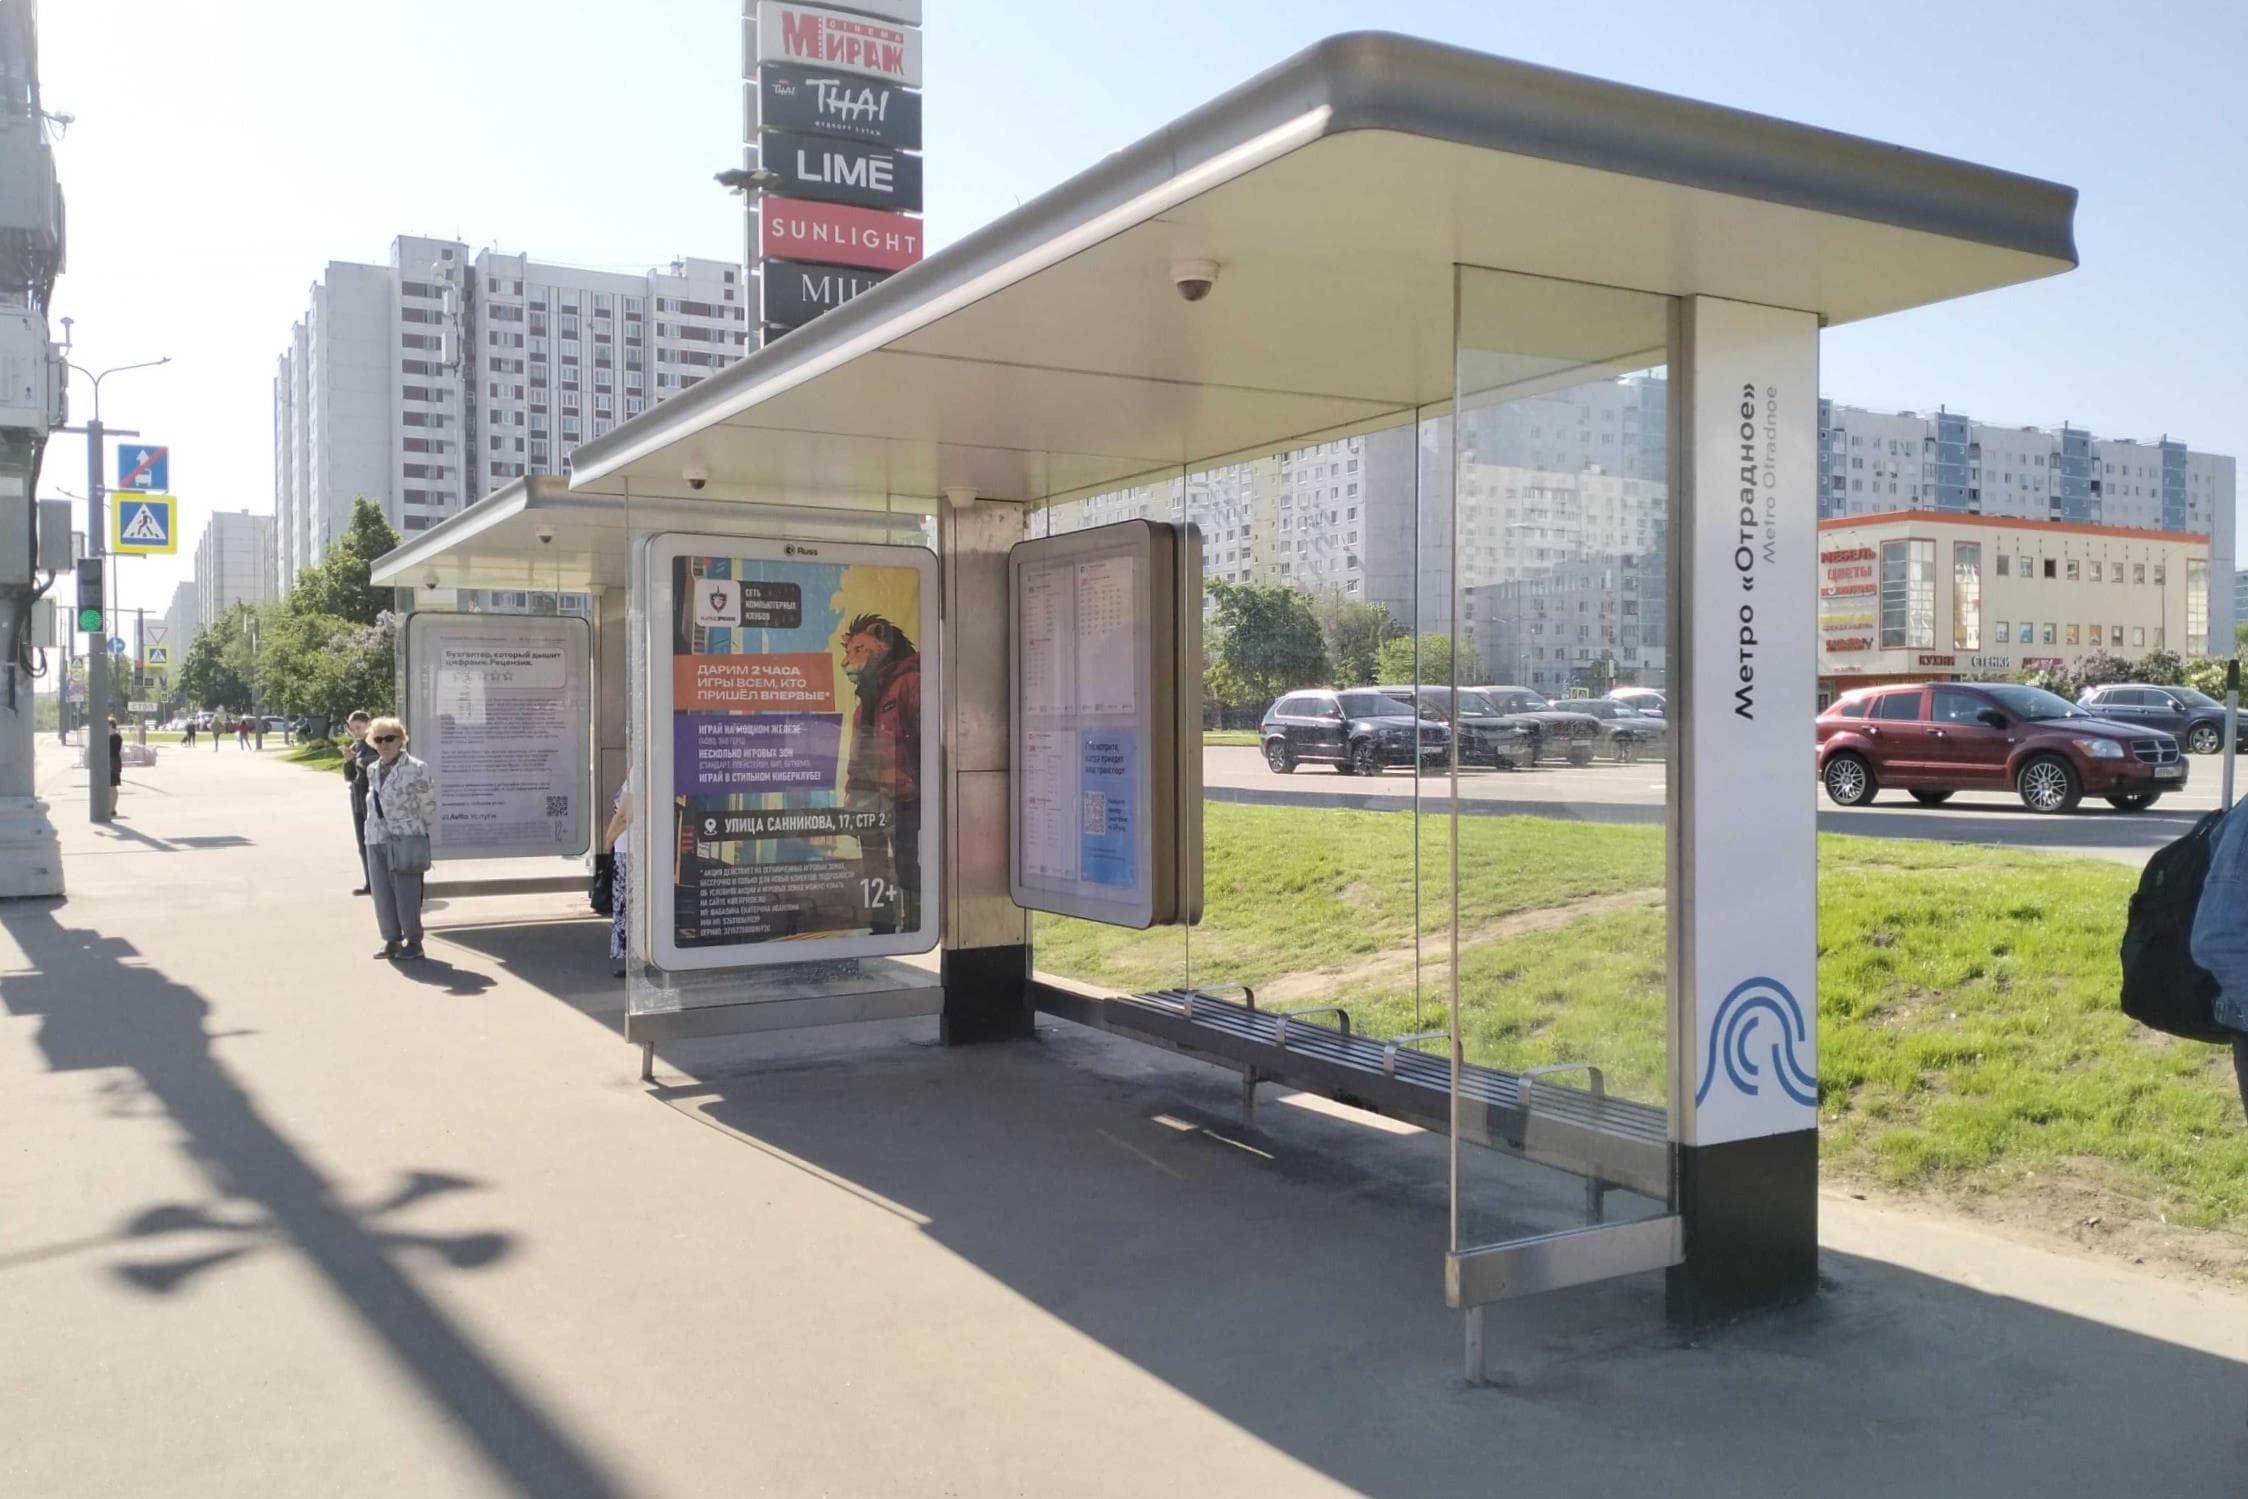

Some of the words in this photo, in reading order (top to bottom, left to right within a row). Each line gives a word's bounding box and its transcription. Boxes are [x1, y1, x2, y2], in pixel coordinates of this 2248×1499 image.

[782, 10, 904, 75] МИРАЖ
[805, 78, 890, 121] THAI
[772, 217, 916, 256] SUNLIGHT
[1763, 385, 1778, 489] Otradnoe
[1735, 382, 1758, 593] «Отрадное»
[1763, 496, 1776, 565] Metro
[1827, 566, 1872, 582] ЦВЕТЫ
[745, 588, 761, 597] СЕТЬ
[745, 601, 797, 610] КОМПЬЮТЕРНЫХ
[745, 612, 771, 620] КЛУБОВ
[494, 651, 530, 659] который
[532, 651, 561, 659] дышит
[1919, 655, 1955, 666] КУХНИ
[1972, 655, 2010, 668] СТЕНКИ
[1735, 605, 1758, 720] Метро
[697, 665, 748, 676] ДАРИМ
[751, 665, 761, 675] 2
[763, 666, 801, 675] ЧАСА
[697, 677, 734, 688] ИГРЫ
[737, 678, 778, 689] ВСЕМ,
[781, 679, 807, 688] КТО
[697, 689, 758, 700] ПРИШЁЛ
[699, 723, 723, 734] ИГРАЙ
[725, 725, 735, 734] НА
[736, 725, 770, 736] МОЩНОМ
[699, 749, 742, 758] НЕСКОЛЬКО
[743, 748, 778, 758] ИГРОВЫХ
[779, 748, 794, 758] ЗОН
[699, 771, 723, 783] ИГРАЙ
[725, 772, 730, 782] В
[732, 772, 771, 782] СТИЛЬНОМ
[772, 771, 821, 781] КИБЕРКЛУБЕ!
[724, 818, 764, 835] УЛИЦА
[767, 815, 836, 832] САННИКОВА,
[839, 814, 853, 829] 17,
[856, 814, 876, 828] СТР
[879, 813, 886, 827] 2
[859, 877, 898, 909] 12+
